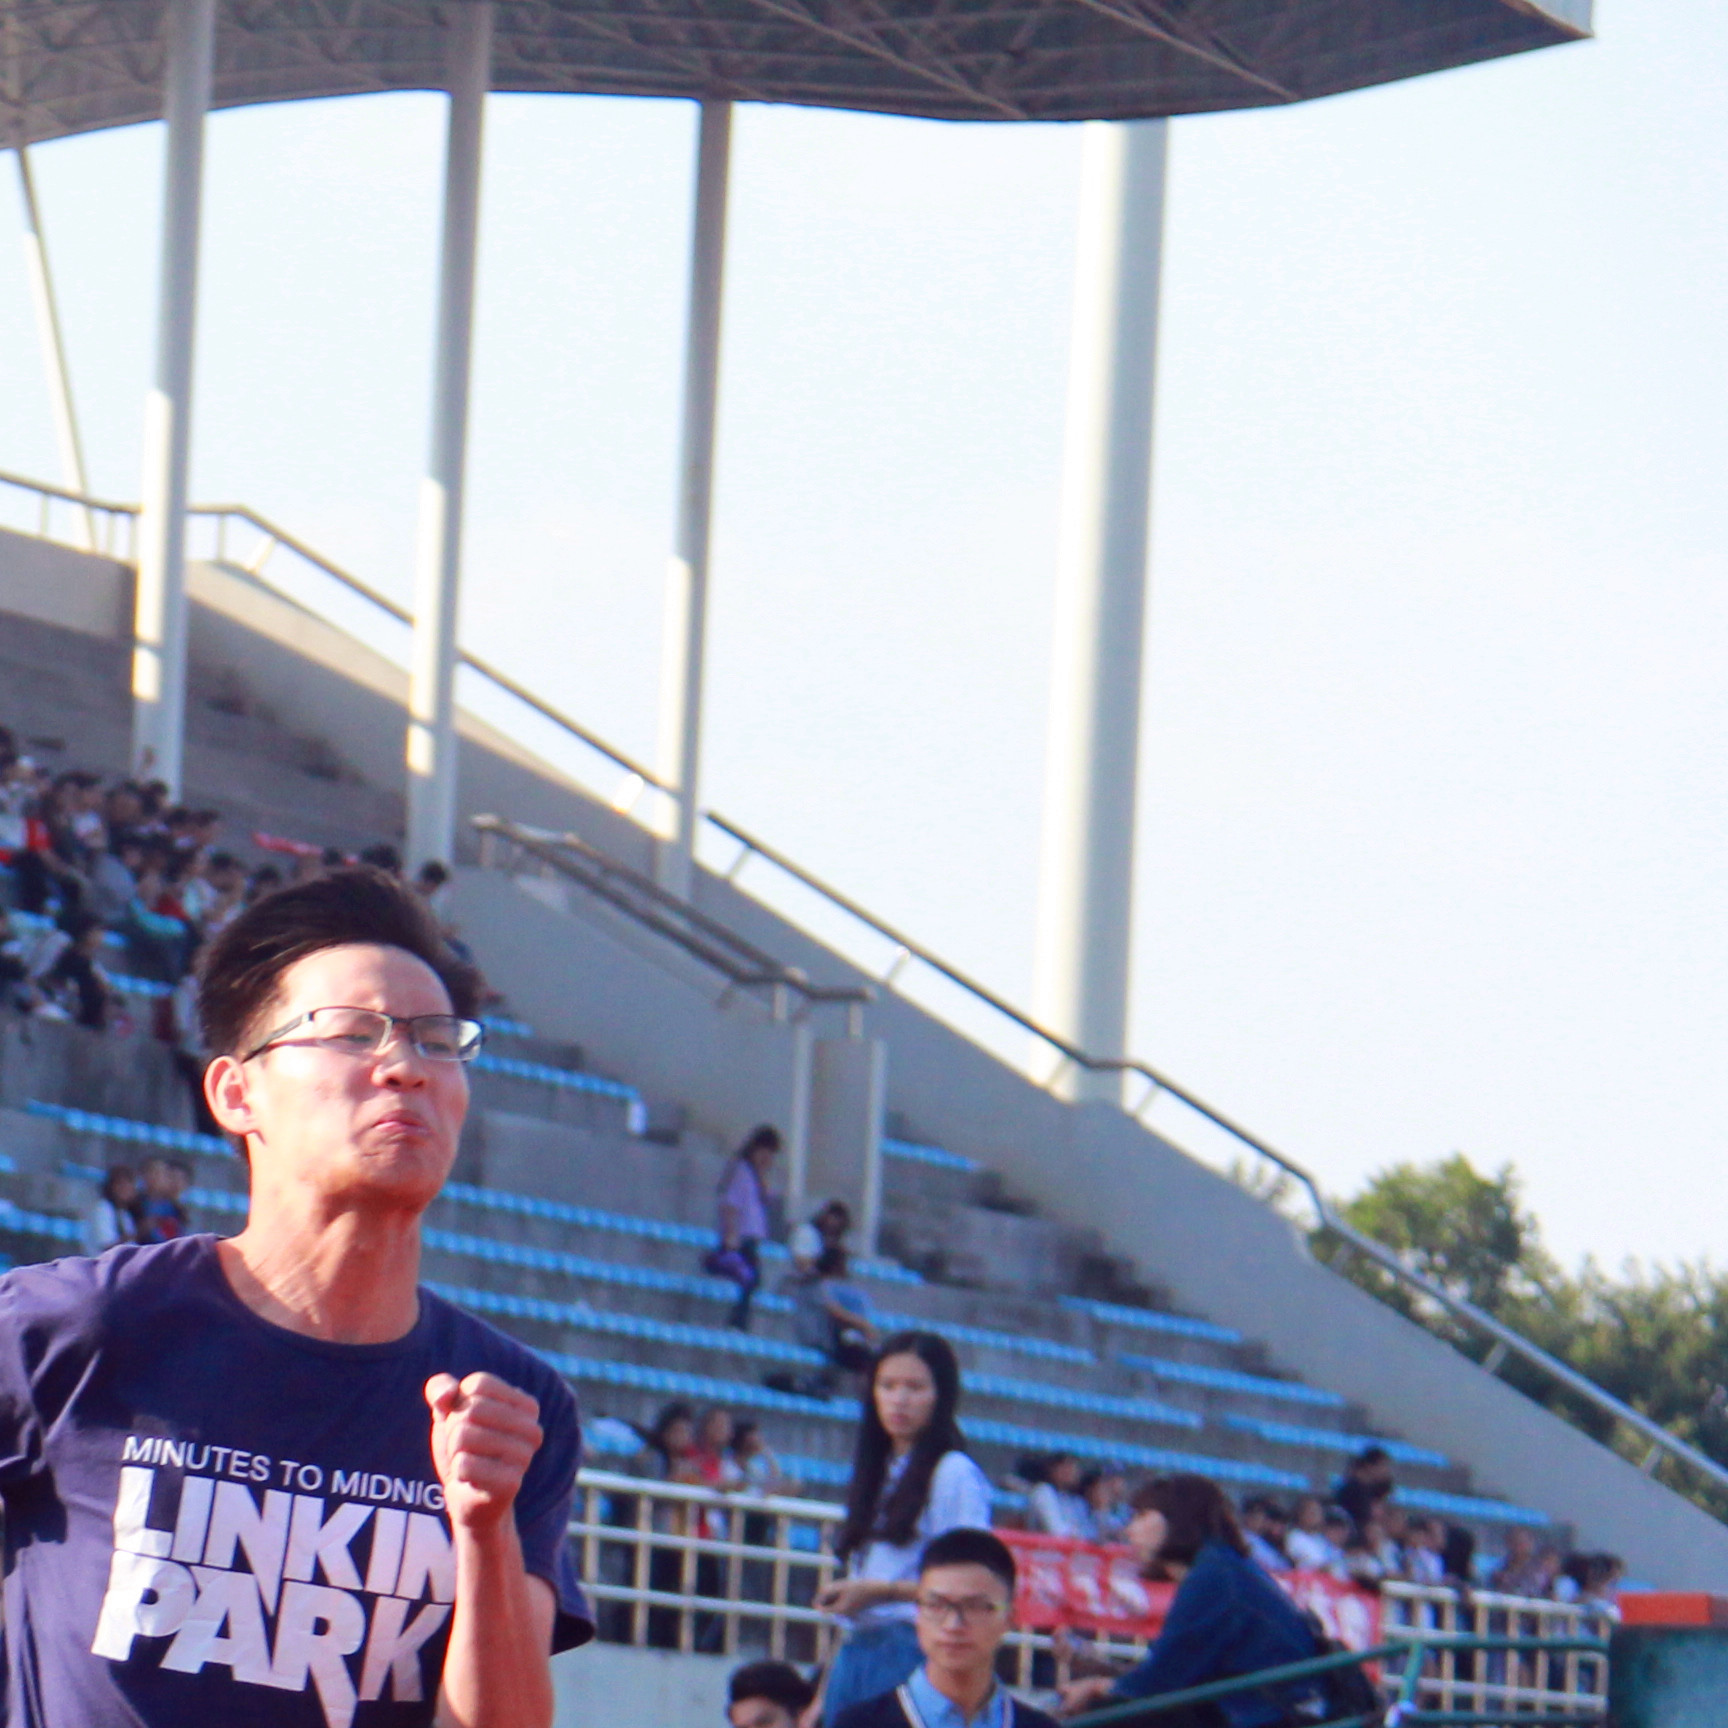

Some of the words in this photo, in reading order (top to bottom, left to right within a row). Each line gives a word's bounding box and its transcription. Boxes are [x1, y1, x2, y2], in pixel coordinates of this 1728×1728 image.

[121, 1435, 271, 1482] MINUTES
[280, 1460, 324, 1491] TO
[331, 1469, 445, 1509] MIDNIG
[113, 1466, 457, 1617] LINKIN
